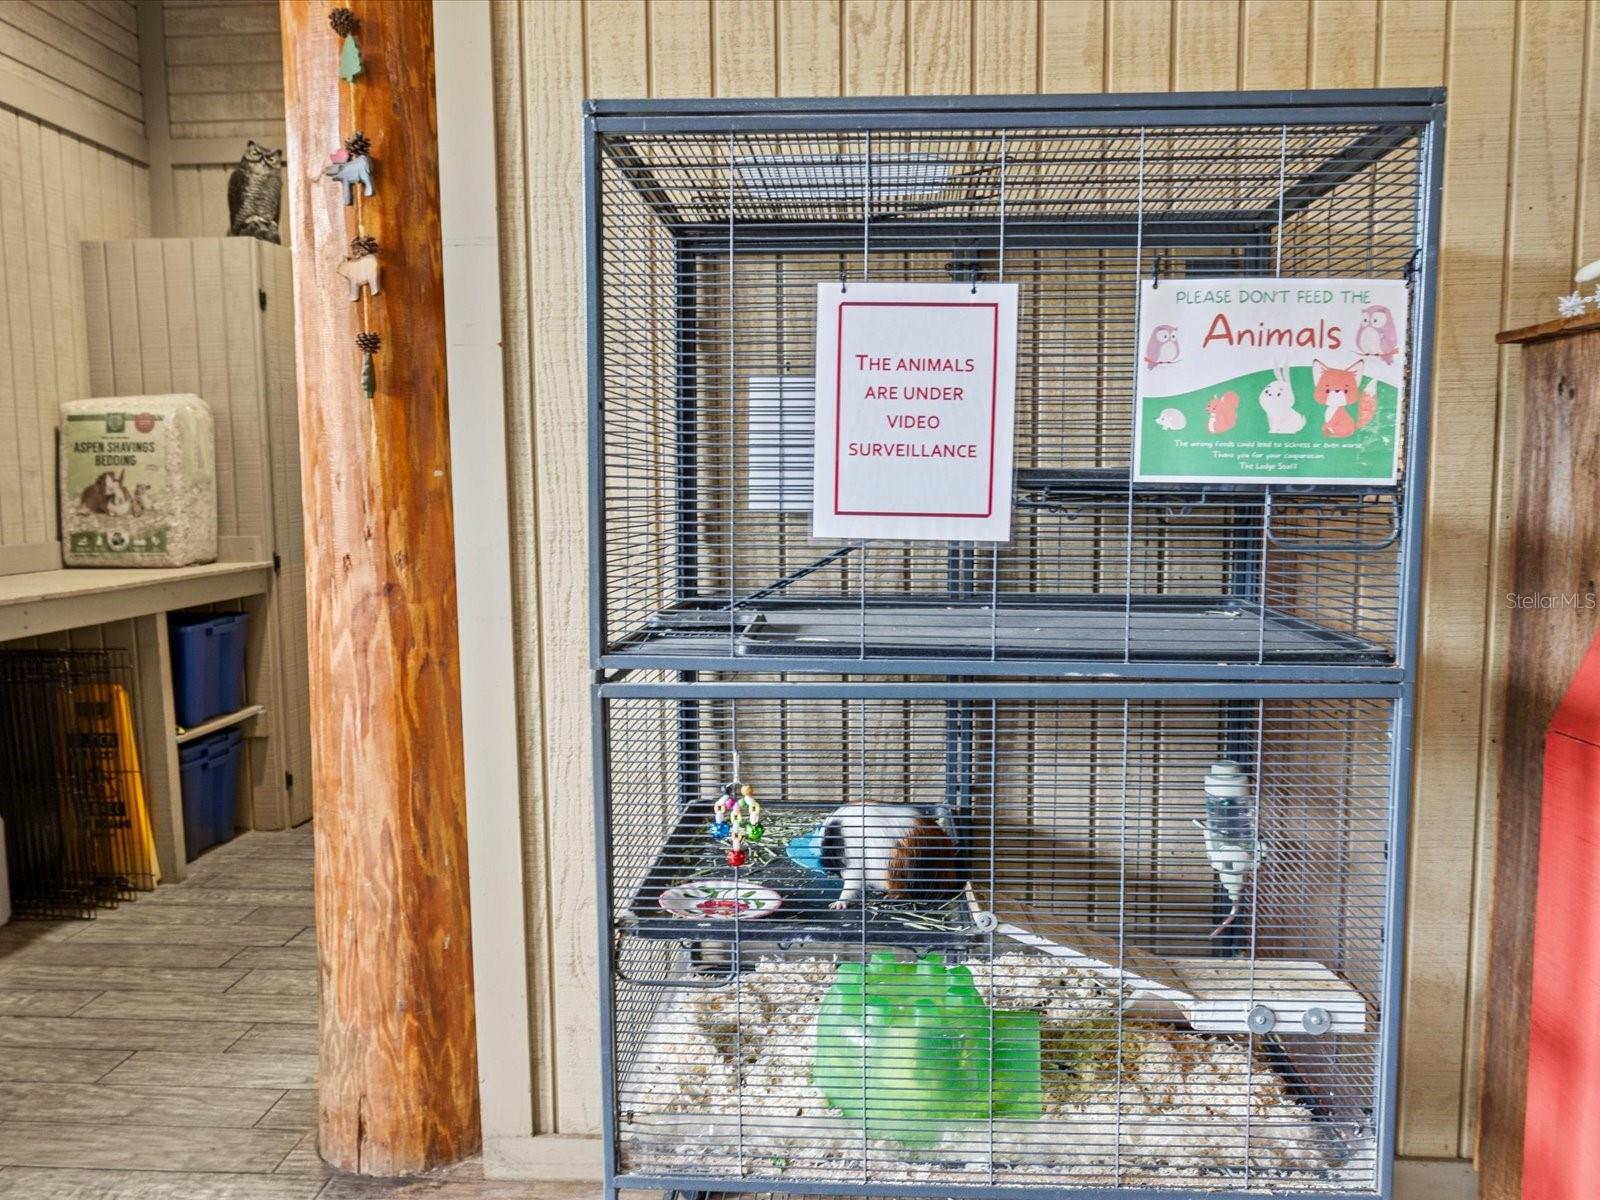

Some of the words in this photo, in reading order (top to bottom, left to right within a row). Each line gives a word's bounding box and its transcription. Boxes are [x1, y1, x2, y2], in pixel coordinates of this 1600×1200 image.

[1176, 290, 1232, 304] PLEASE
[1239, 290, 1290, 303] DON'T
[1297, 290, 1334, 304] FEED
[1341, 290, 1371, 304] THE
[1202, 313, 1342, 350] Animals
[856, 354, 891, 371] THE
[896, 358, 975, 372] ANIMALS
[864, 386, 898, 400] ARE
[903, 387, 964, 400] UNDER
[887, 415, 940, 429] VIDEO
[74, 441, 105, 453] ASPEN
[107, 441, 155, 453] SHAVINGS
[848, 443, 977, 458] SURVEILLANCE
[1174, 439, 1189, 448] The
[95, 455, 137, 466] BEDDING
[1239, 461, 1254, 470] The
